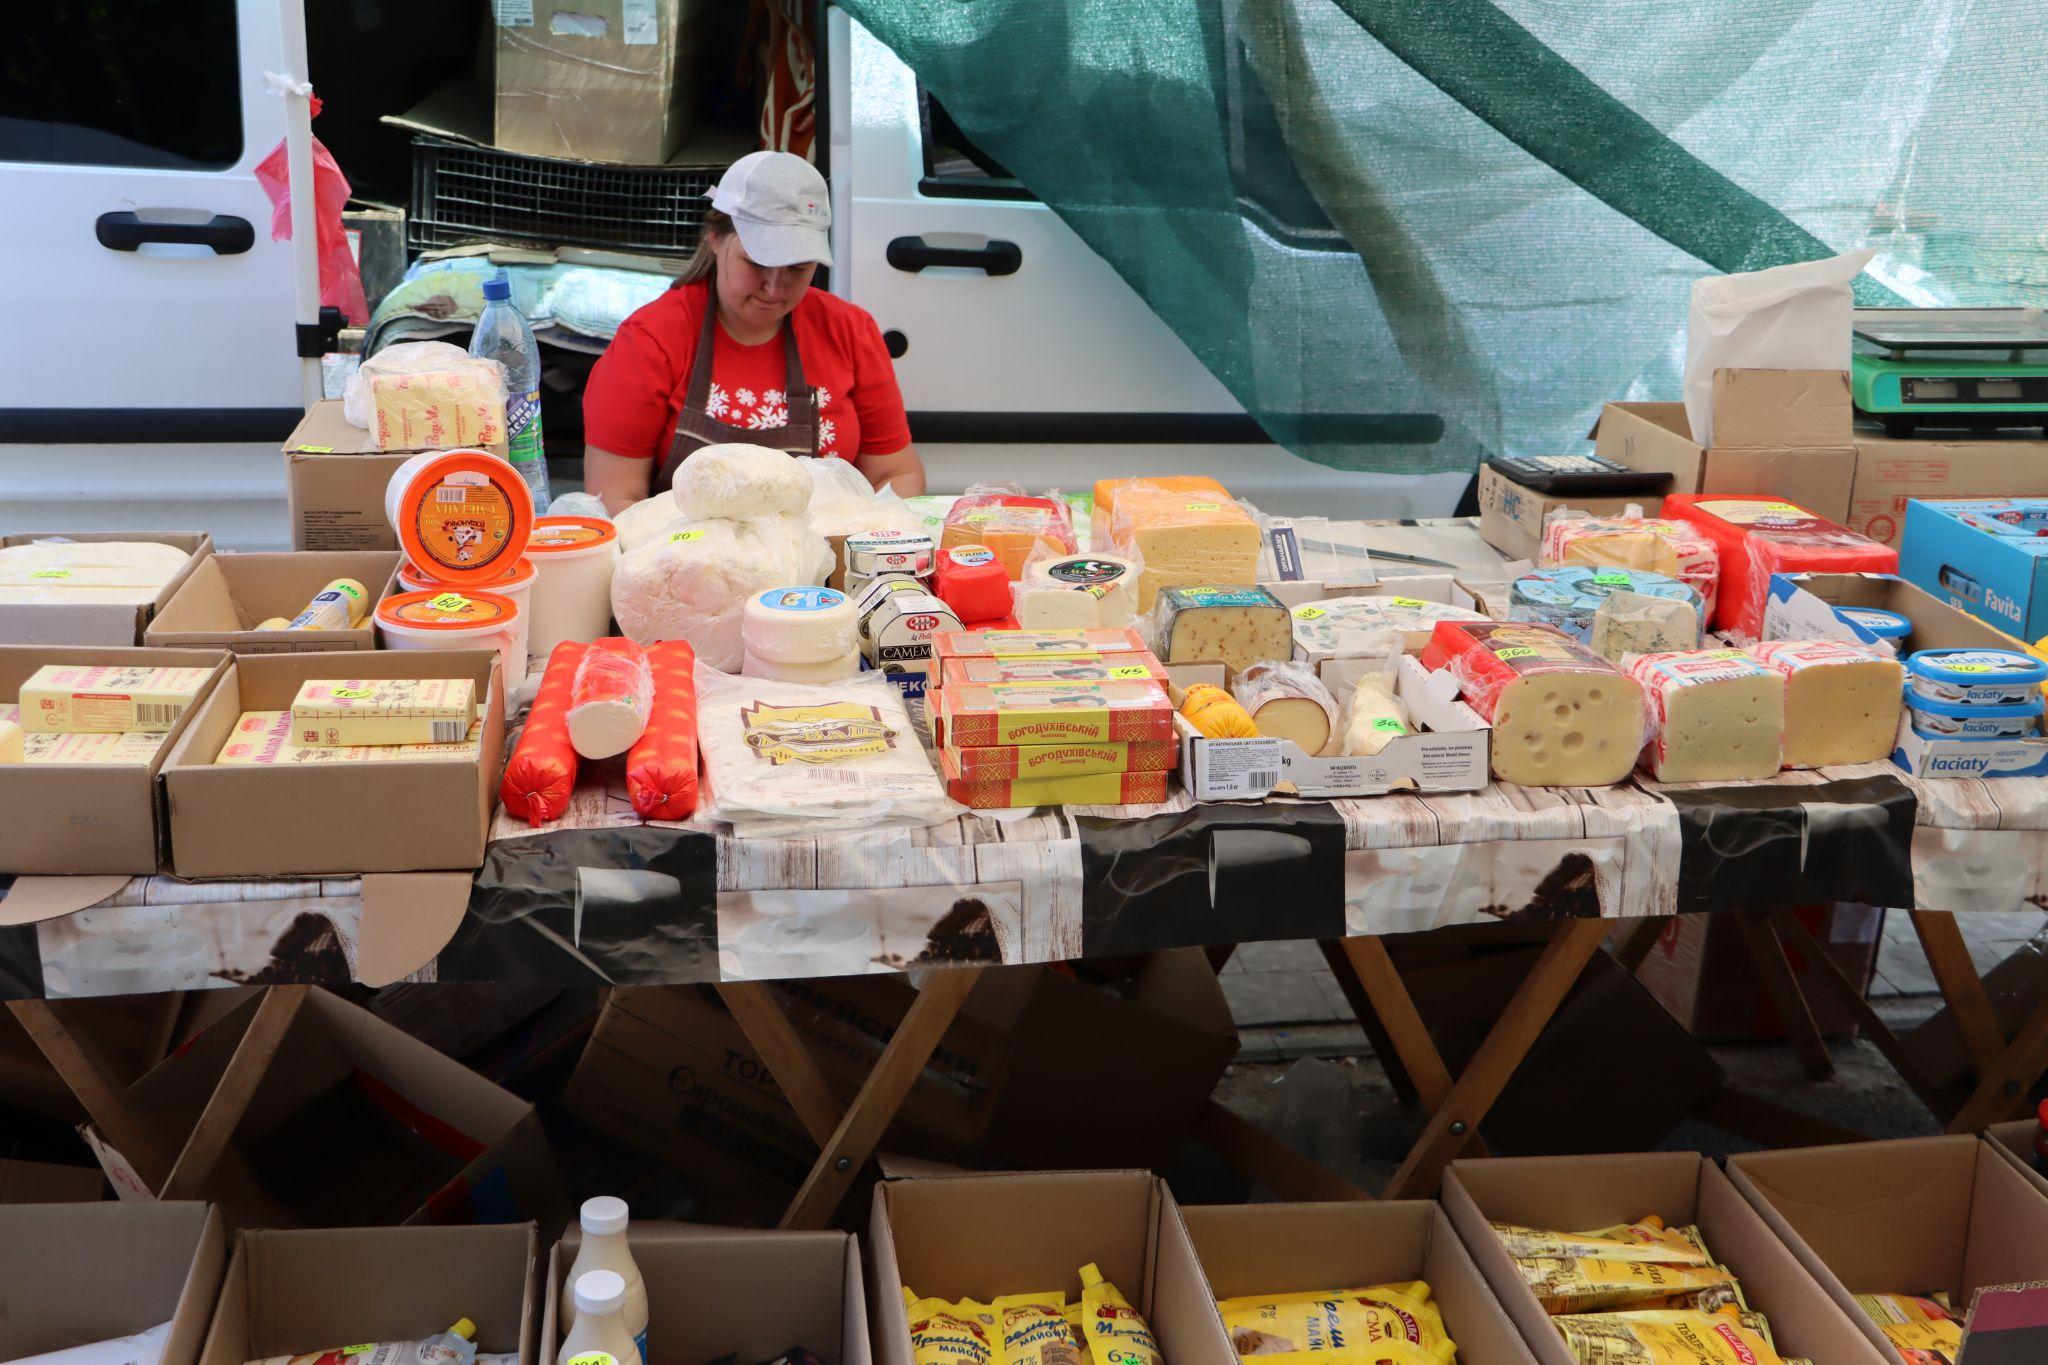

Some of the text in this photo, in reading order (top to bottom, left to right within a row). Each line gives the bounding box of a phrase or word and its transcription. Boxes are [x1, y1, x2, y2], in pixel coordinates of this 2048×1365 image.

[436, 597, 461, 609] 60
[1984, 588, 2022, 623] Favita
[1120, 667, 1142, 676] 45
[1008, 722, 1100, 740] БОГОДУХІВСЬКИЙ
[1028, 748, 1118, 767] БОГОДУХІВСЬКИЙ
[1281, 756, 1291, 766] kg
[1931, 757, 1990, 772] łaciaty
[1718, 1324, 1755, 1365] ЩЕДРО
